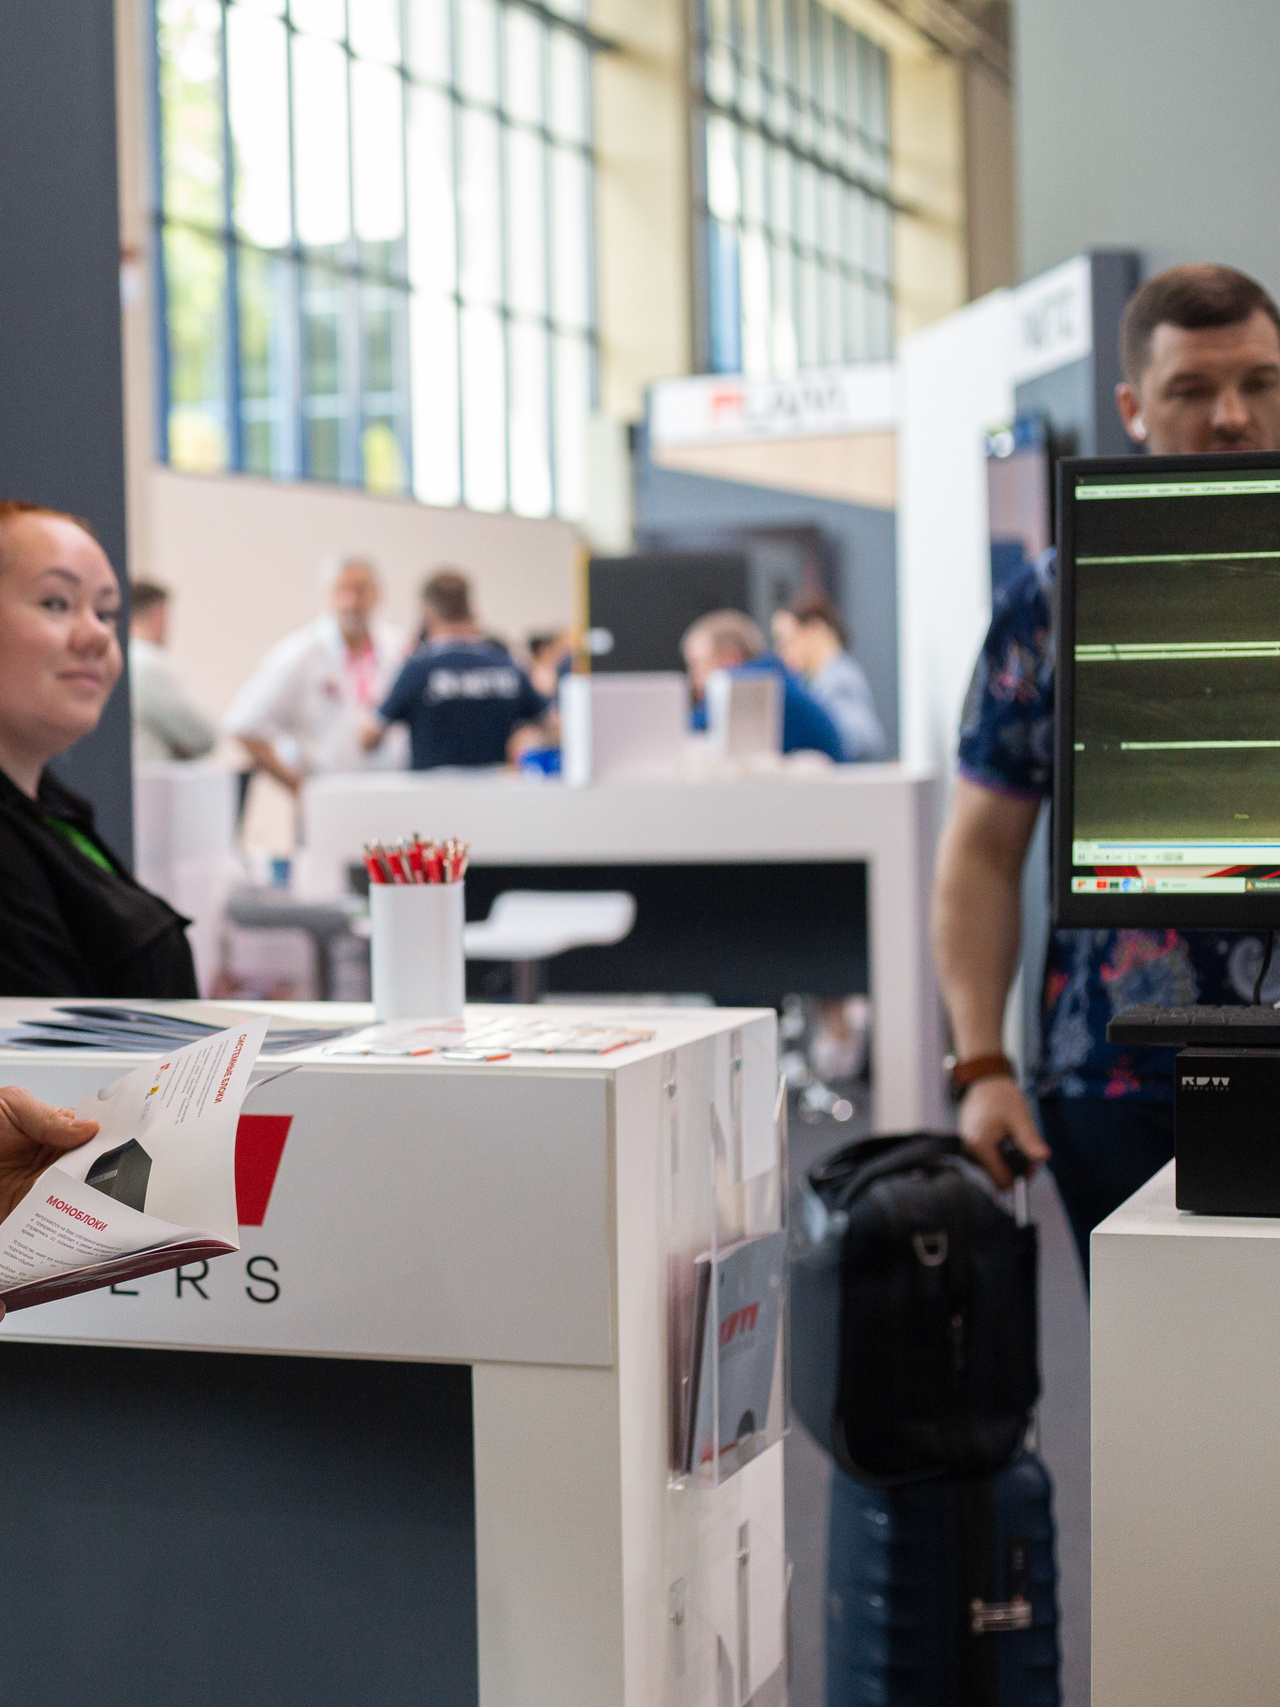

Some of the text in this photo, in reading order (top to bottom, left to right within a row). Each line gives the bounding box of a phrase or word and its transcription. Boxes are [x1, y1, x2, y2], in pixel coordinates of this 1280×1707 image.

[214, 1032, 248, 1104] СИСТЕМНЫЕ БЛОКИ
[45, 1194, 109, 1232] МОНОБЛОКИ
